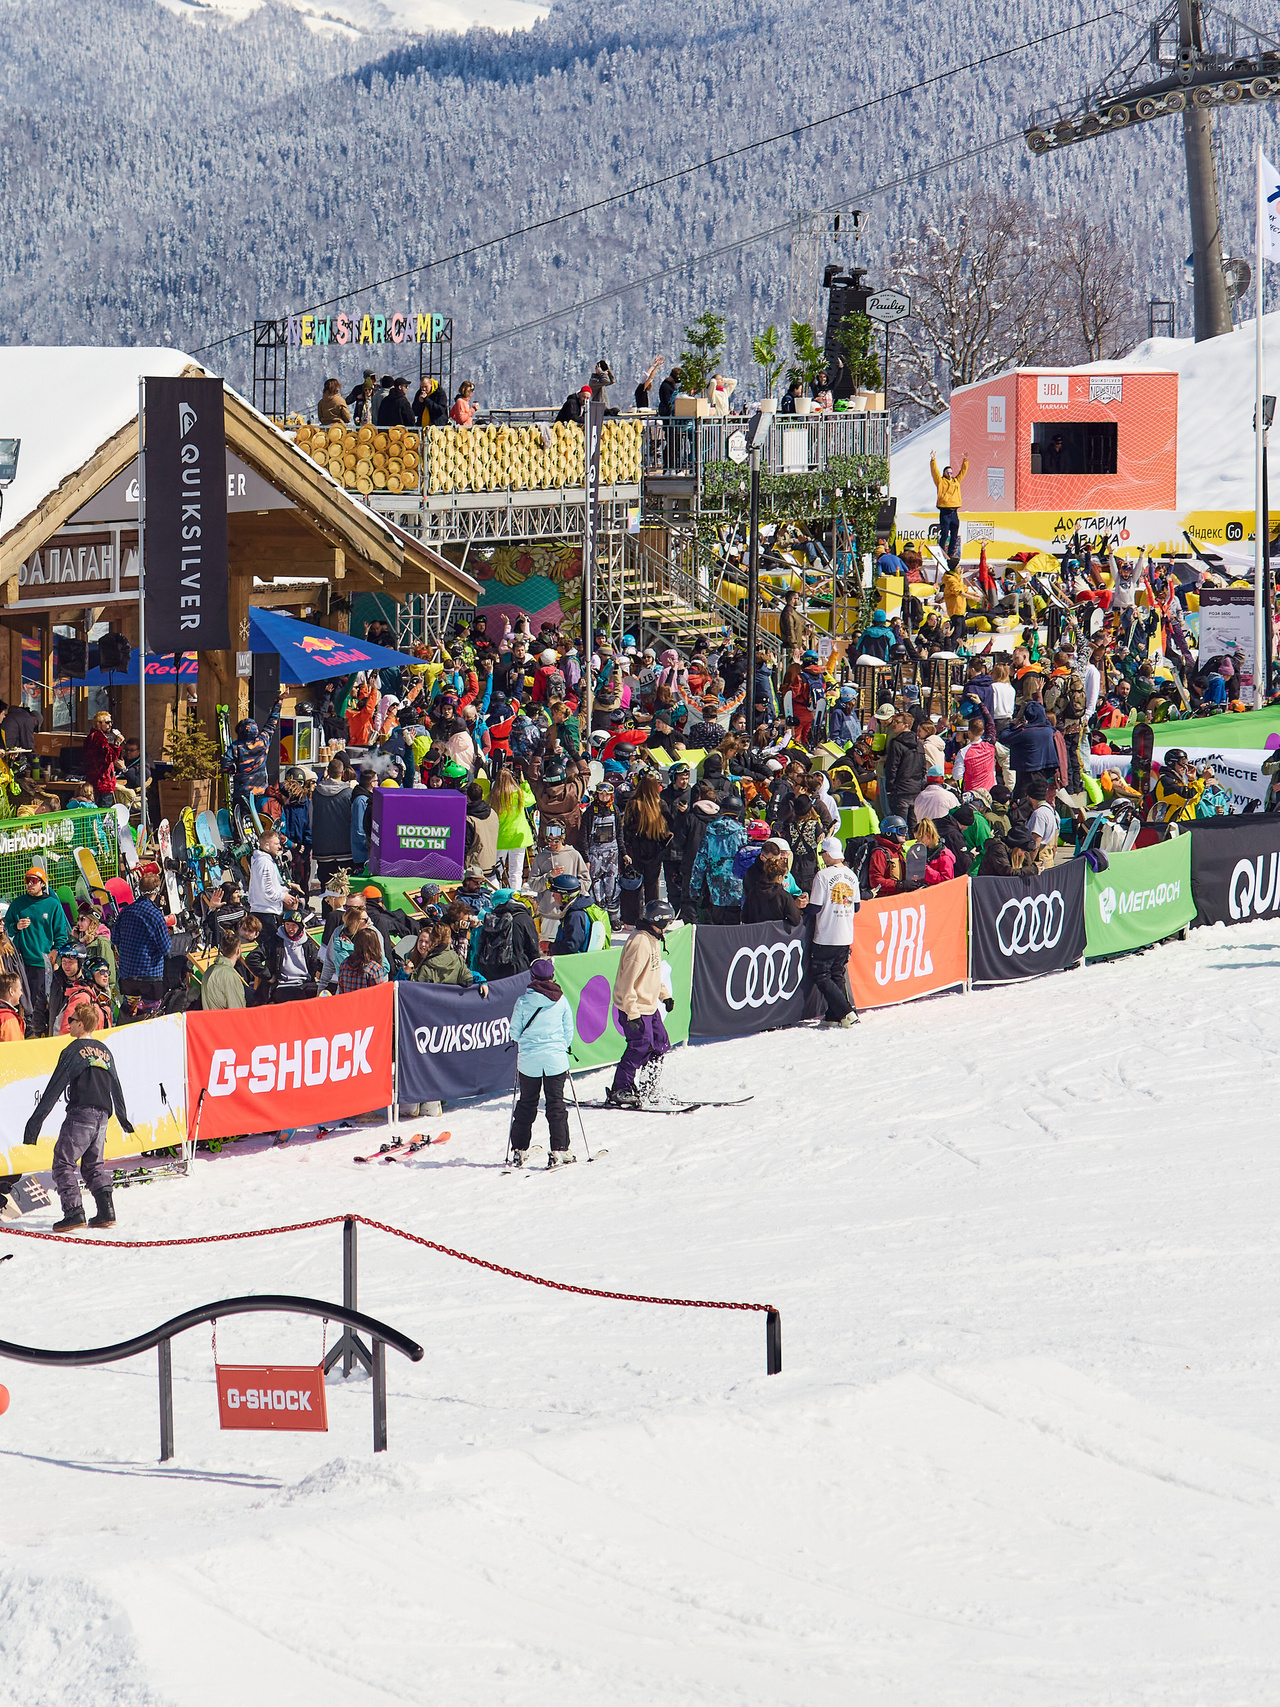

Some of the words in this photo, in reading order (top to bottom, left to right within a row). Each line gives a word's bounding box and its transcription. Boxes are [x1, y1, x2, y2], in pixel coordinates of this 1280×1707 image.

[869, 298, 907, 315] Paulig
[287, 314, 330, 346] NEW
[336, 313, 386, 345] STAR
[391, 312, 444, 343] CAMP
[1043, 383, 1063, 396] JBL
[180, 442, 202, 631] QUIKSILVER
[897, 528, 926, 541] ндекс
[1227, 525, 1242, 539] Go
[238, 654, 250, 667] WC
[398, 825, 450, 837] ПОТОМУ
[401, 838, 426, 849] ЧТО
[427, 839, 445, 850] ТЫ
[874, 904, 934, 986] JBL
[207, 1026, 375, 1097] G-SHOCK
[226, 1387, 313, 1412] G-SHOCK
